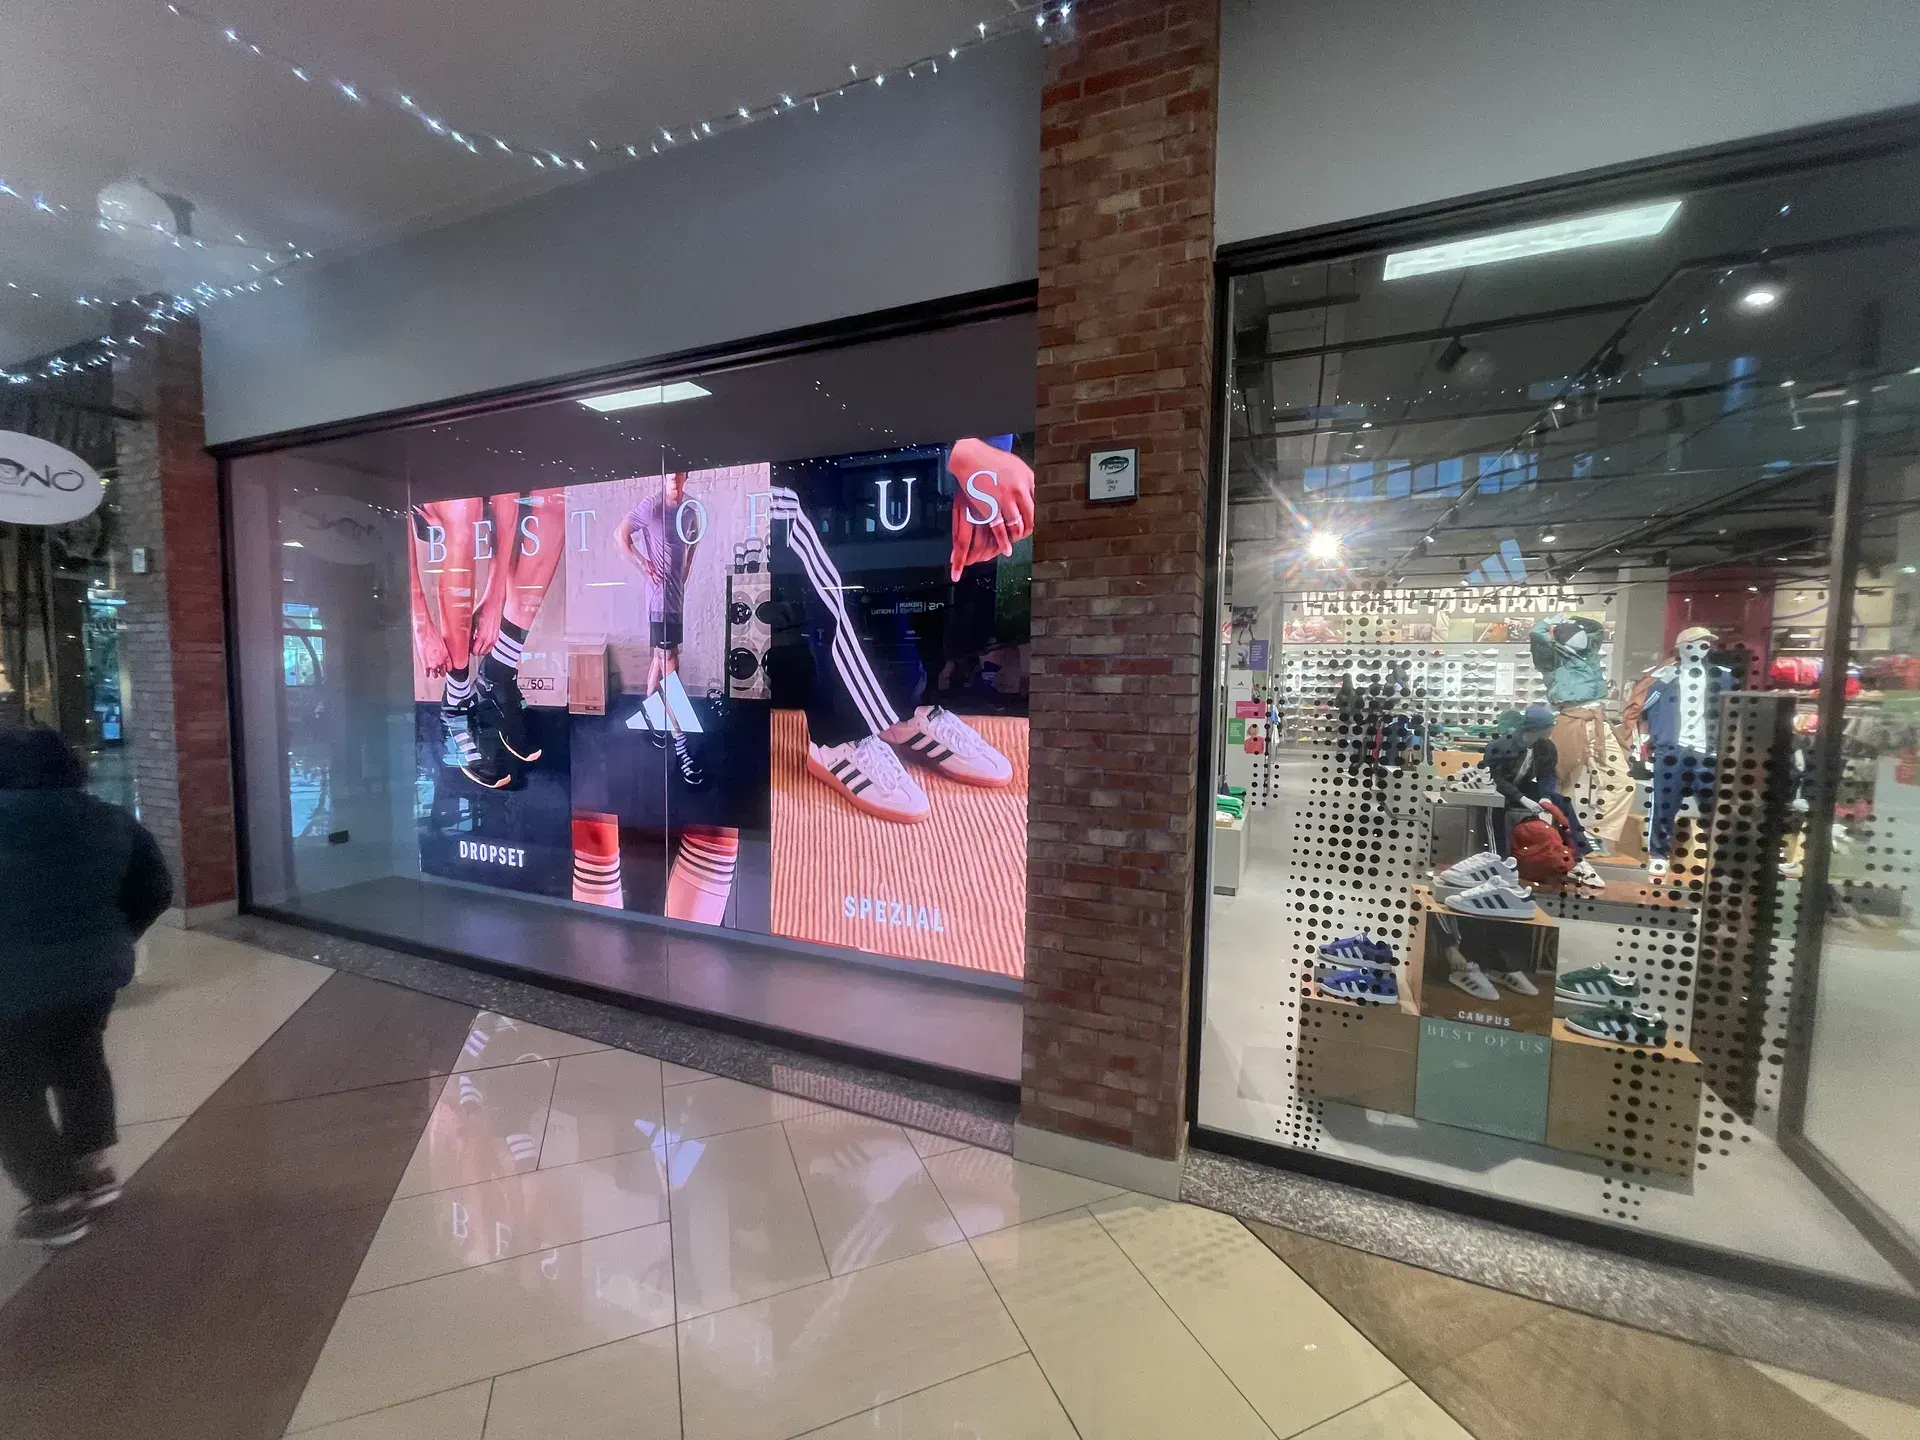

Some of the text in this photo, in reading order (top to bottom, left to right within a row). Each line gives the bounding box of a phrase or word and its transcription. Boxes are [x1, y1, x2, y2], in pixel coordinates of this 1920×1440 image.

[427, 509, 597, 564] BEST
[675, 491, 774, 545] OF
[875, 470, 1000, 531] US
[1302, 585, 1577, 616] WELCOME TO CATANIA
[459, 840, 526, 869] DROPSET
[843, 894, 945, 932] SPEZIAL
[1458, 1010, 1511, 1027] CAMPUS
[1427, 1024, 1544, 1054] BEST OF US
